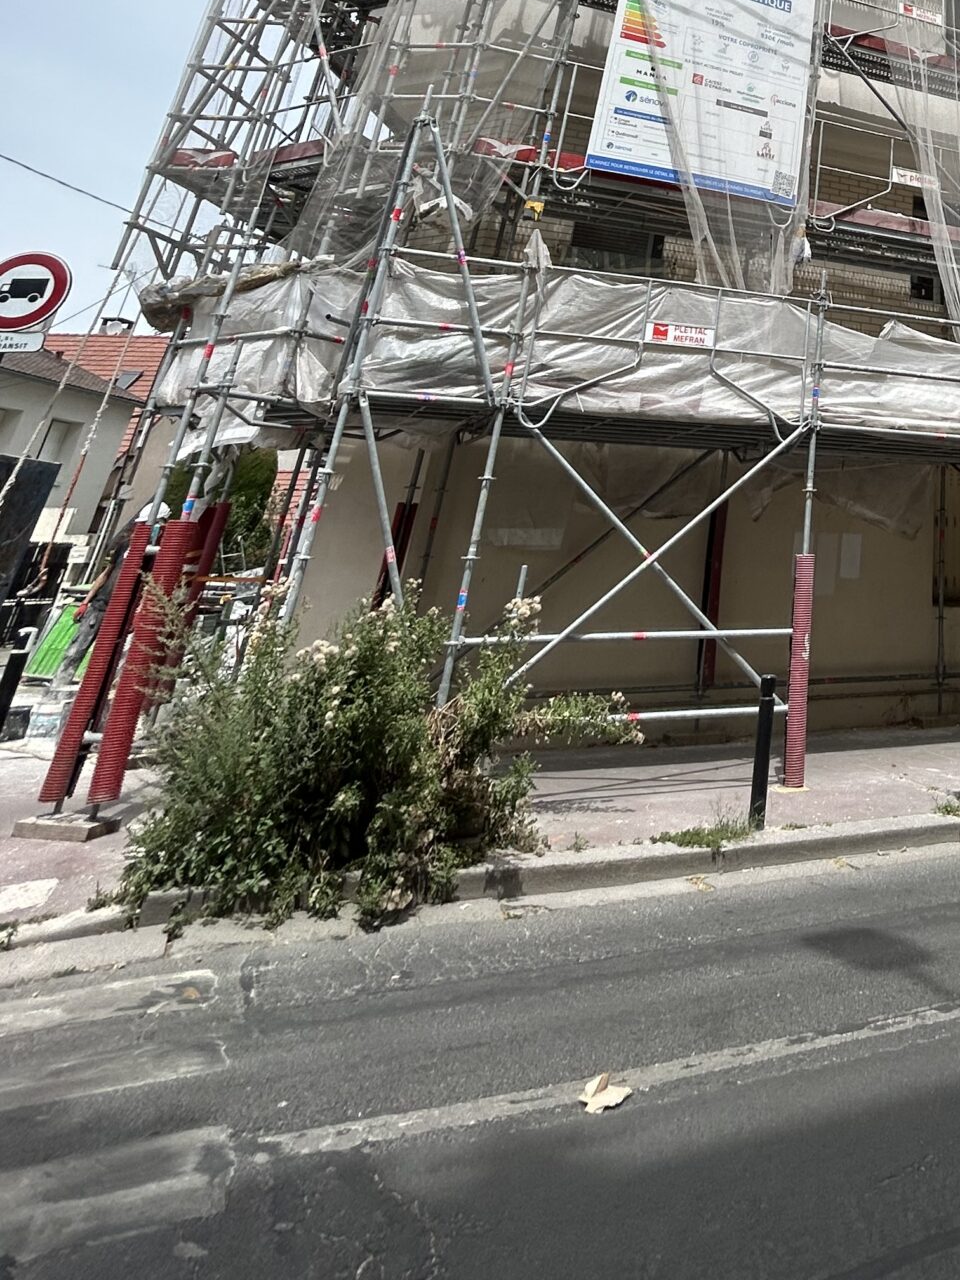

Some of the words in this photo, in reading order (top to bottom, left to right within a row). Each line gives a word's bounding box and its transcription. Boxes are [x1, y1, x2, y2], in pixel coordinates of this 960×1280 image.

[718, 34, 737, 45] VOTRE
[640, 95, 665, 107] sénov
[673, 335, 705, 344] MEFRAN
